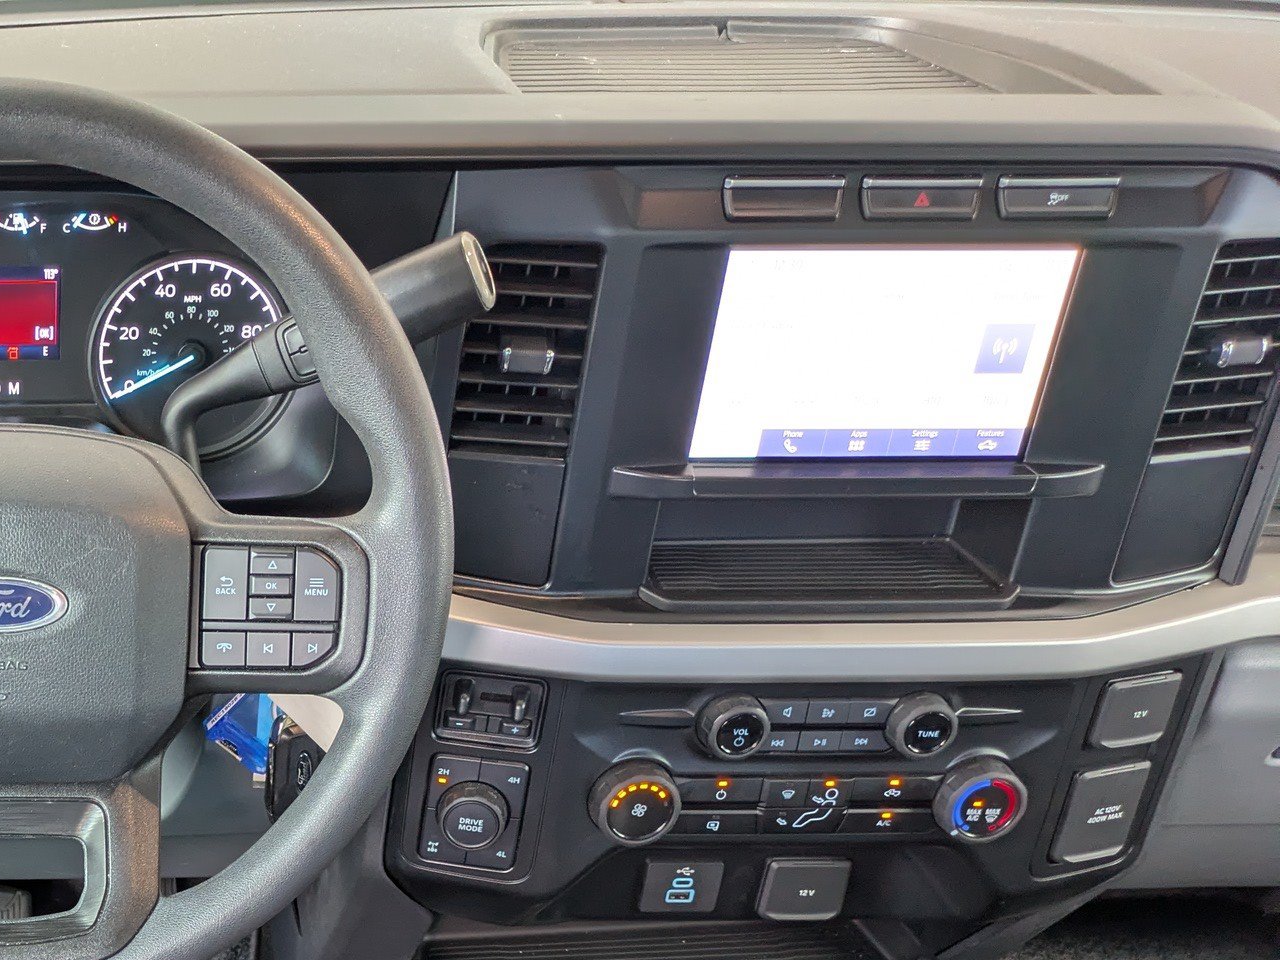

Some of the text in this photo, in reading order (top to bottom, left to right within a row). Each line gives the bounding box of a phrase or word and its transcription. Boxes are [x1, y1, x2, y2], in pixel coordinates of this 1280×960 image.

[41, 223, 47, 233] F
[62, 223, 70, 233] C
[119, 222, 126, 233] H
[155, 284, 176, 298] 40
[210, 284, 232, 298] 60
[165, 312, 174, 320] 60
[207, 310, 218, 318] 100
[224, 324, 234, 332] 120
[120, 327, 139, 340] 20
[42, 346, 48, 356] E
[8, 382, 20, 395] M
[783, 430, 804, 438] Phone
[851, 430, 868, 439] Apps
[912, 430, 938, 438] Settings
[977, 430, 1004, 438] Features
[918, 730, 940, 738] TUNE
[1094, 804, 1121, 816] AC 120V
[459, 817, 484, 826] DRIVE
[1087, 812, 1123, 824] 400W MAX
[458, 824, 483, 832] MODE
